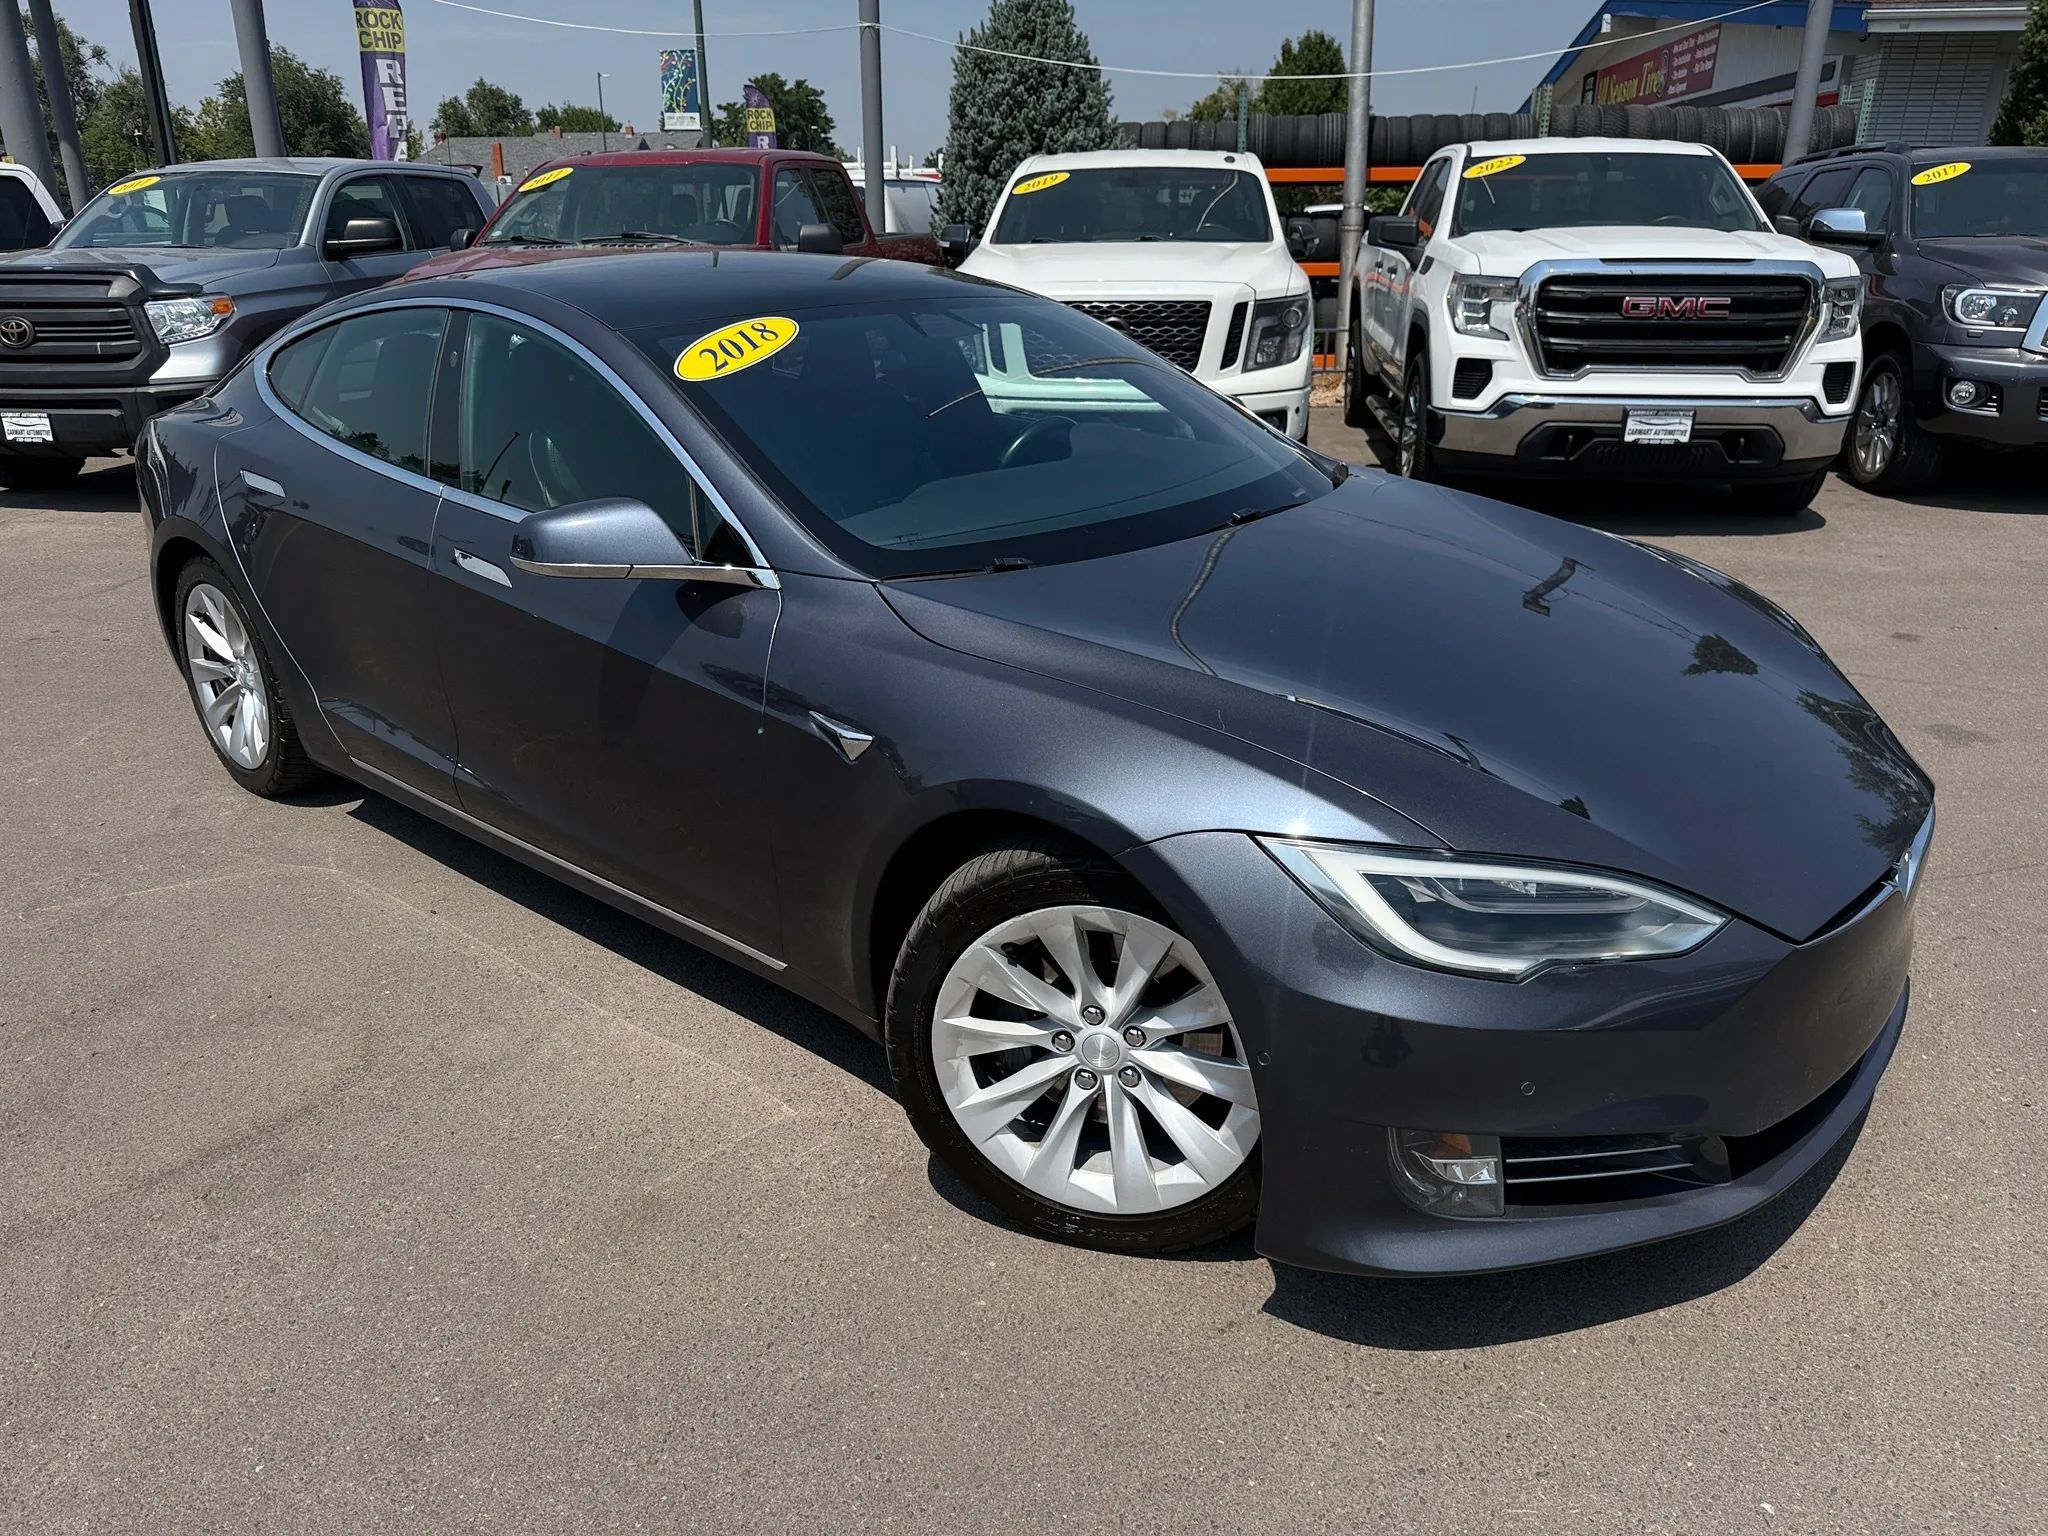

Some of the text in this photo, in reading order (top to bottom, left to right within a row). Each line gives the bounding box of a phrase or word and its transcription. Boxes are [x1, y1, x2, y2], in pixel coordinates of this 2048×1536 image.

[355, 9, 403, 30] ROCK
[360, 30, 402, 49] CHIP
[1610, 75, 1639, 104] Season
[747, 109, 773, 120] ROCK
[750, 120, 772, 130] CHIP
[1476, 157, 1513, 175] 2022
[1922, 164, 1957, 182] 2017
[1024, 174, 1058, 191] 2019
[1622, 296, 1731, 317] GMC
[699, 322, 779, 372] 2018
[1627, 428, 1688, 437] CARMART AUTOMOTIVE
